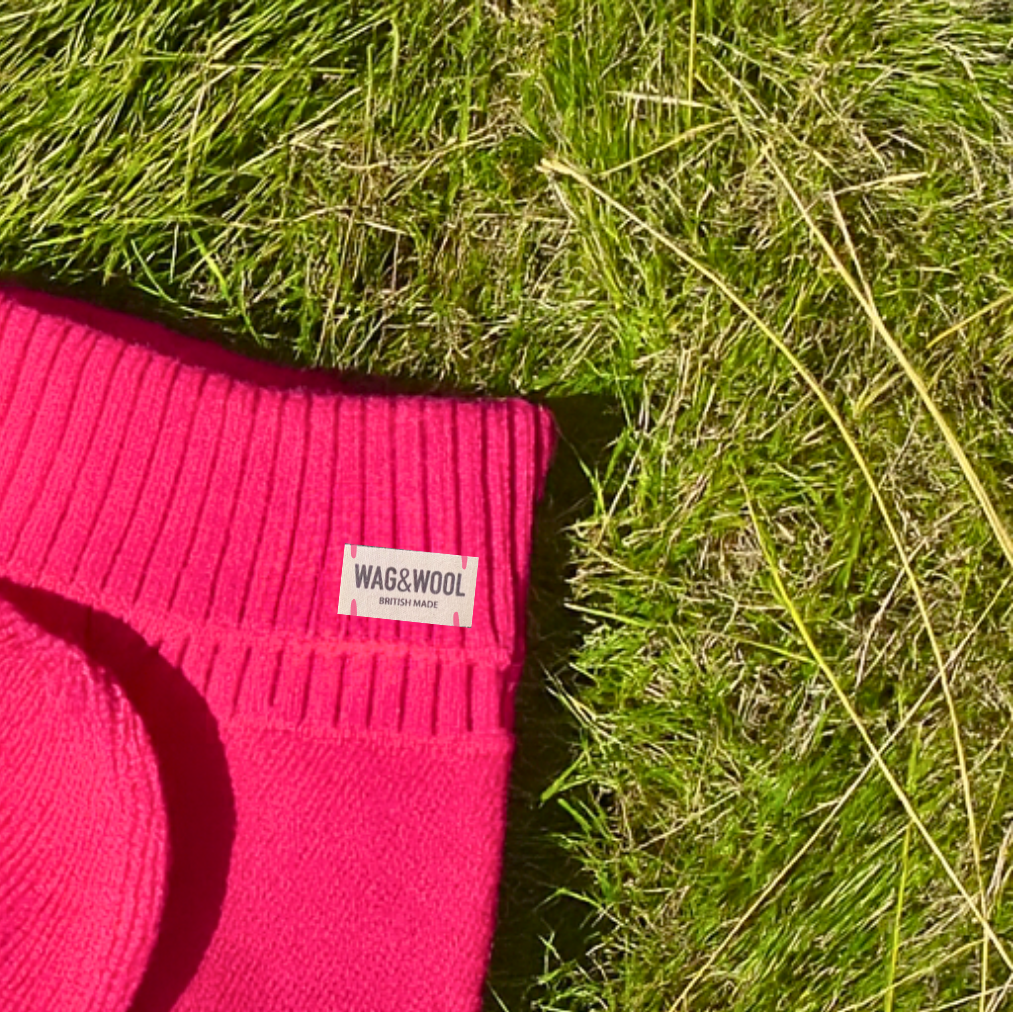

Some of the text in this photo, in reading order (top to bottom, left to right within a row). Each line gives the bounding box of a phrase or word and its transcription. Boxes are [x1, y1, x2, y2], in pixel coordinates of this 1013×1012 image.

[355, 564, 465, 597] WAG&WOOL
[379, 597, 438, 608] BRITISH MADE
